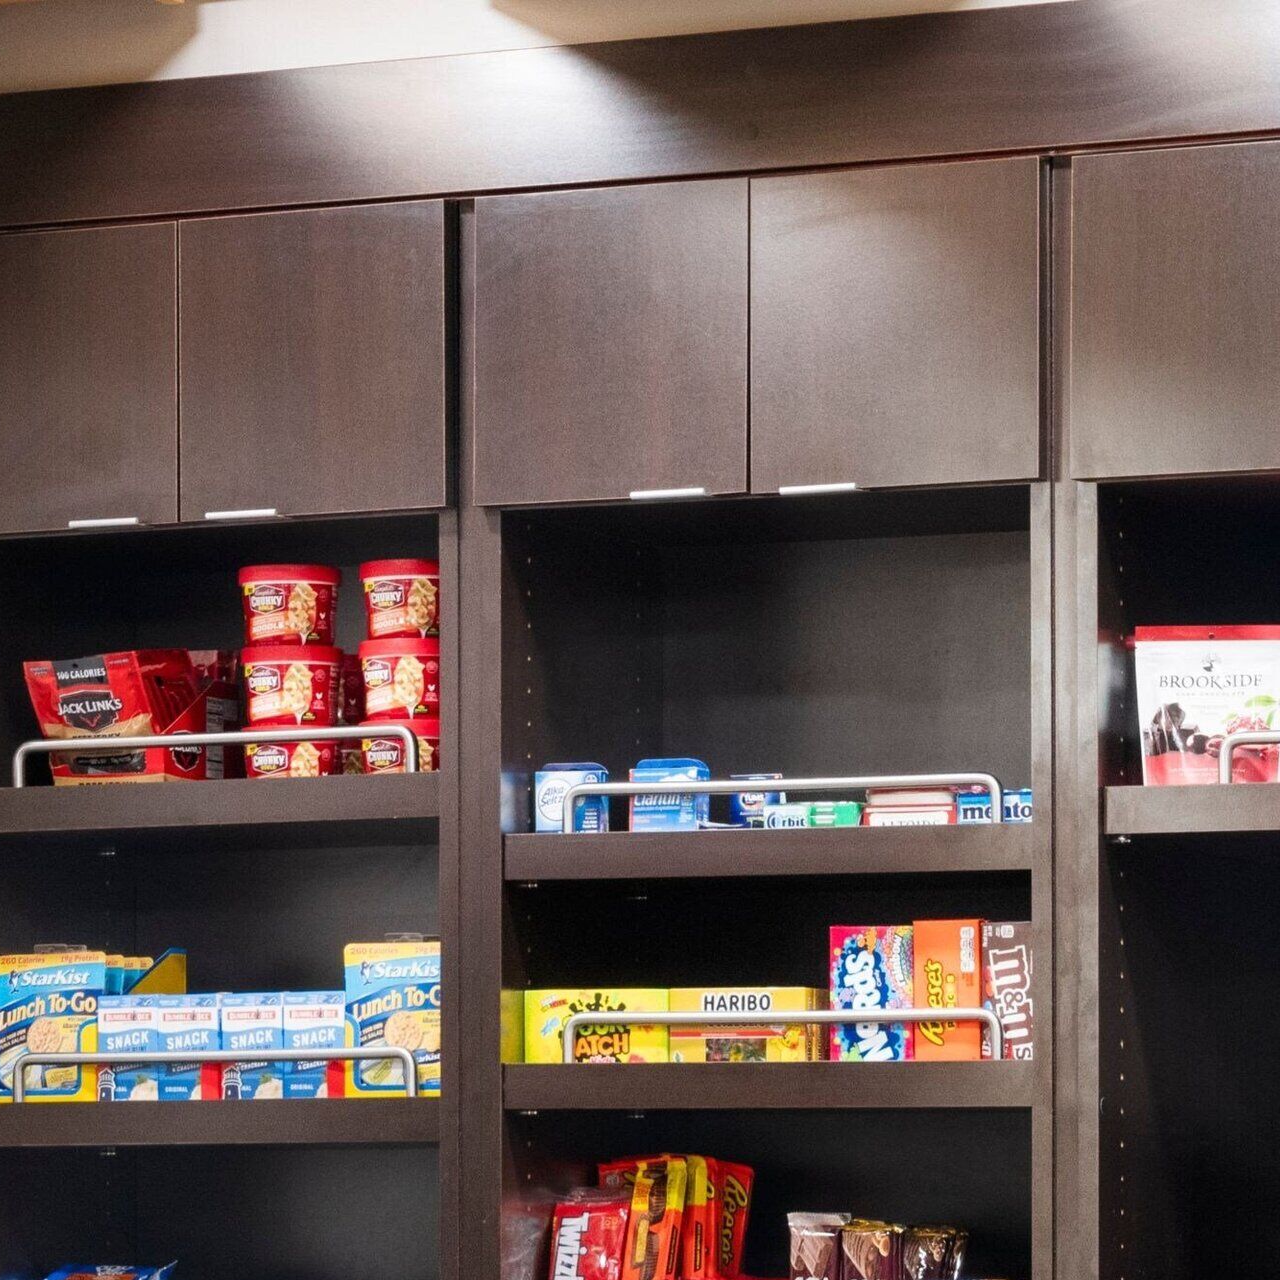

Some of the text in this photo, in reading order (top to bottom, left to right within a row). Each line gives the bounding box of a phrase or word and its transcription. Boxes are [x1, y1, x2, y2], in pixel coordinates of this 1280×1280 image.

[70, 667, 106, 679] CALORIES
[1158, 673, 1263, 691] BROOKSIDE
[57, 701, 86, 716] JACK
[17, 956, 45, 965] Calories
[373, 960, 440, 980] StarKis
[20, 968, 90, 987] StarKist
[352, 989, 403, 1021] Lunch
[703, 993, 772, 1012] HARIBO
[106, 1030, 150, 1050] SNACK
[166, 1031, 209, 1050] SNACK
[230, 1030, 274, 1049] SNACK
[292, 1028, 336, 1048] SNACK
[574, 1033, 631, 1057] ATCH
